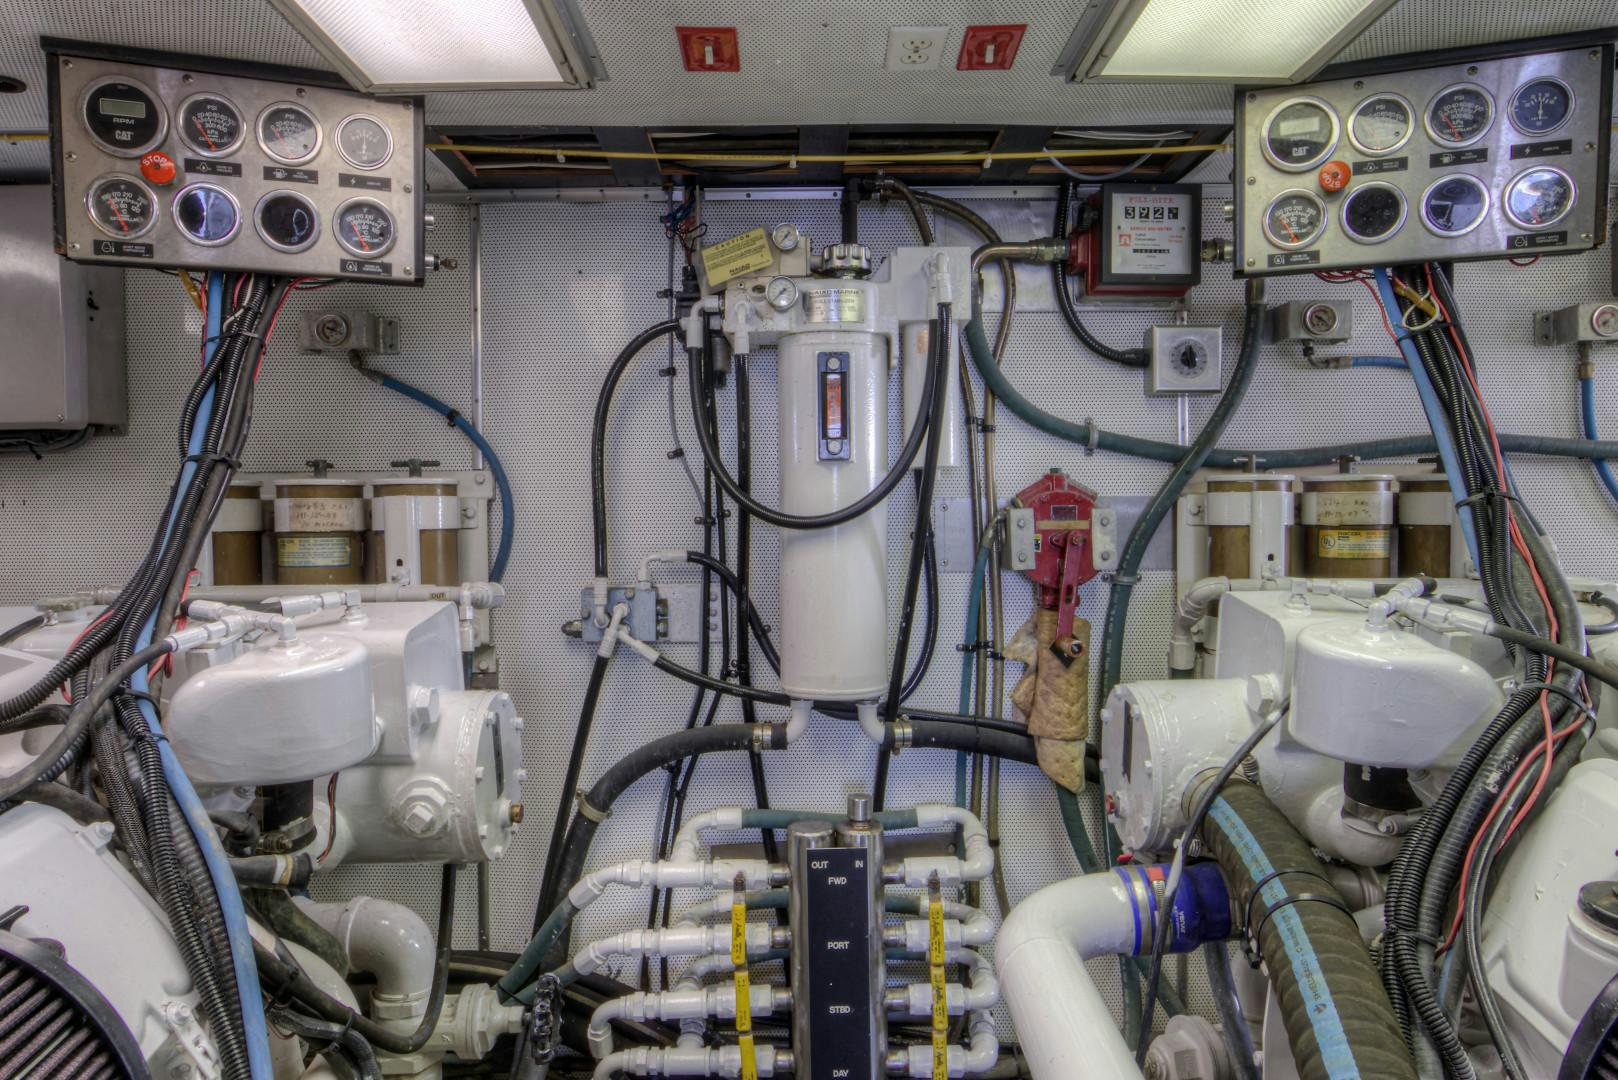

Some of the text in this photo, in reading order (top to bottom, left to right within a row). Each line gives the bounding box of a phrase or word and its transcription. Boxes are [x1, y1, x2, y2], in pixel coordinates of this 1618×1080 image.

[112, 117, 135, 125] RPM
[115, 131, 135, 141] CAT
[1292, 146, 1310, 156] CAT
[812, 860, 864, 869] OUT IN
[828, 877, 847, 885] FWD
[827, 942, 850, 950] PORT
[829, 1005, 851, 1014] STBD
[832, 1070, 849, 1079] DAY
